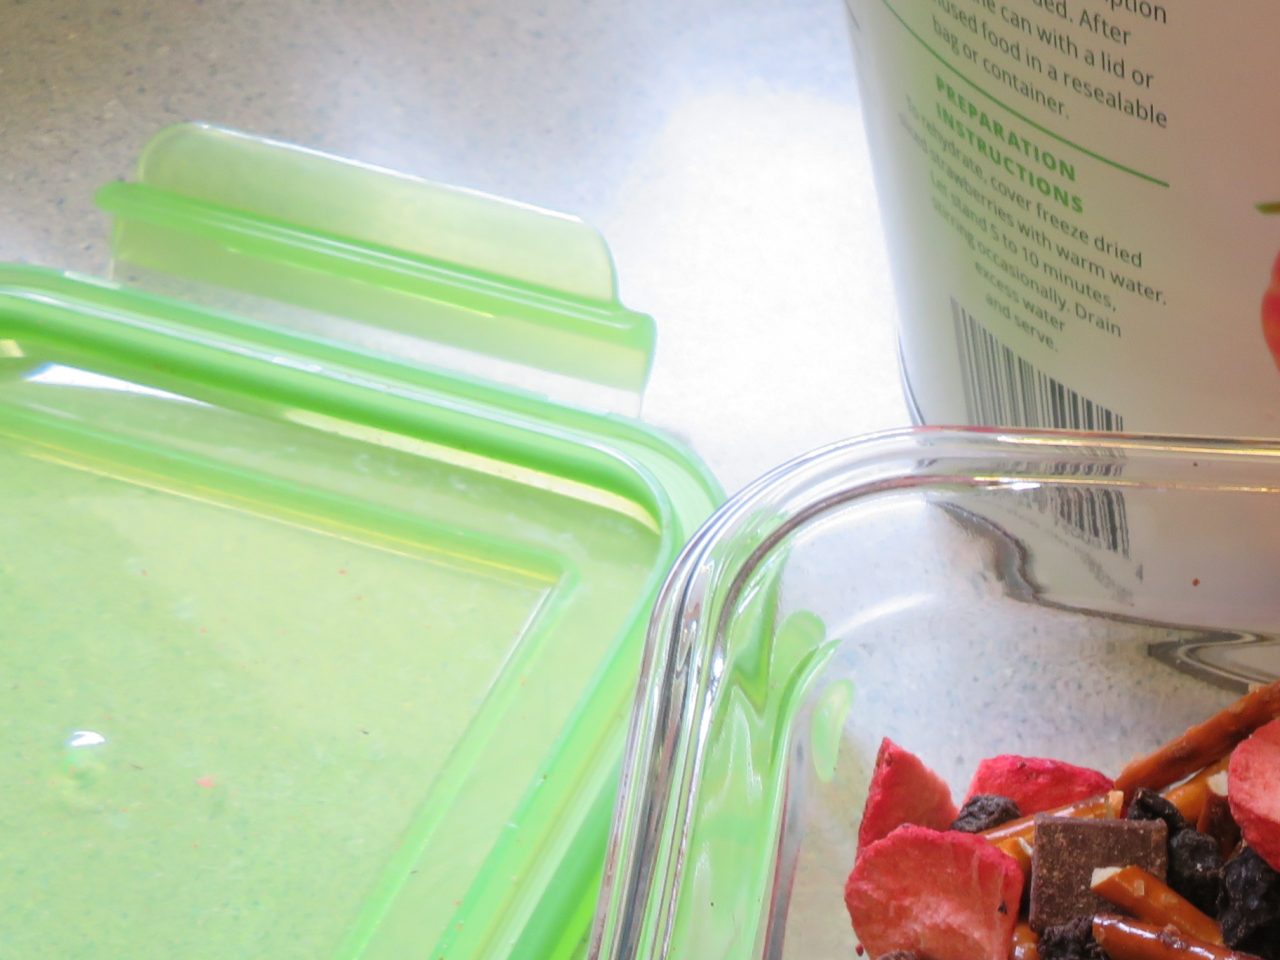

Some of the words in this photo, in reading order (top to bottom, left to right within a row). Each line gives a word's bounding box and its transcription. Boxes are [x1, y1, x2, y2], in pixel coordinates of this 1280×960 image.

[932, 14, 960, 56] bag
[963, 43, 977, 64] or
[983, 57, 1070, 120] container.
[1001, 5, 1032, 35] can
[1037, 23, 1079, 59] with
[1085, 46, 1095, 66] a
[1101, 51, 1125, 78] lid
[1132, 68, 1155, 89] or
[1079, 10, 1131, 45] After
[982, 22, 1020, 61] food
[1027, 49, 1042, 73] in
[1048, 64, 1057, 81] a
[1064, 74, 1167, 128] resealable
[935, 73, 1076, 182] PREPARATION
[936, 102, 1083, 214] INSTRUCTIONS
[930, 149, 1014, 228] strawberries
[1018, 221, 1052, 251] with
[1056, 244, 1105, 279] warm
[1110, 270, 1167, 306] water.
[951, 193, 987, 233] stand
[990, 224, 999, 241] 5
[1002, 234, 1017, 254] to
[1023, 247, 1039, 268] 10
[990, 176, 1032, 212] cover
[1037, 201, 1089, 243] freeze
[1094, 236, 1142, 268] dried
[975, 262, 1018, 301] excess
[1022, 298, 1065, 332] water
[985, 293, 1010, 320] and
[1075, 303, 1121, 337] Drain
